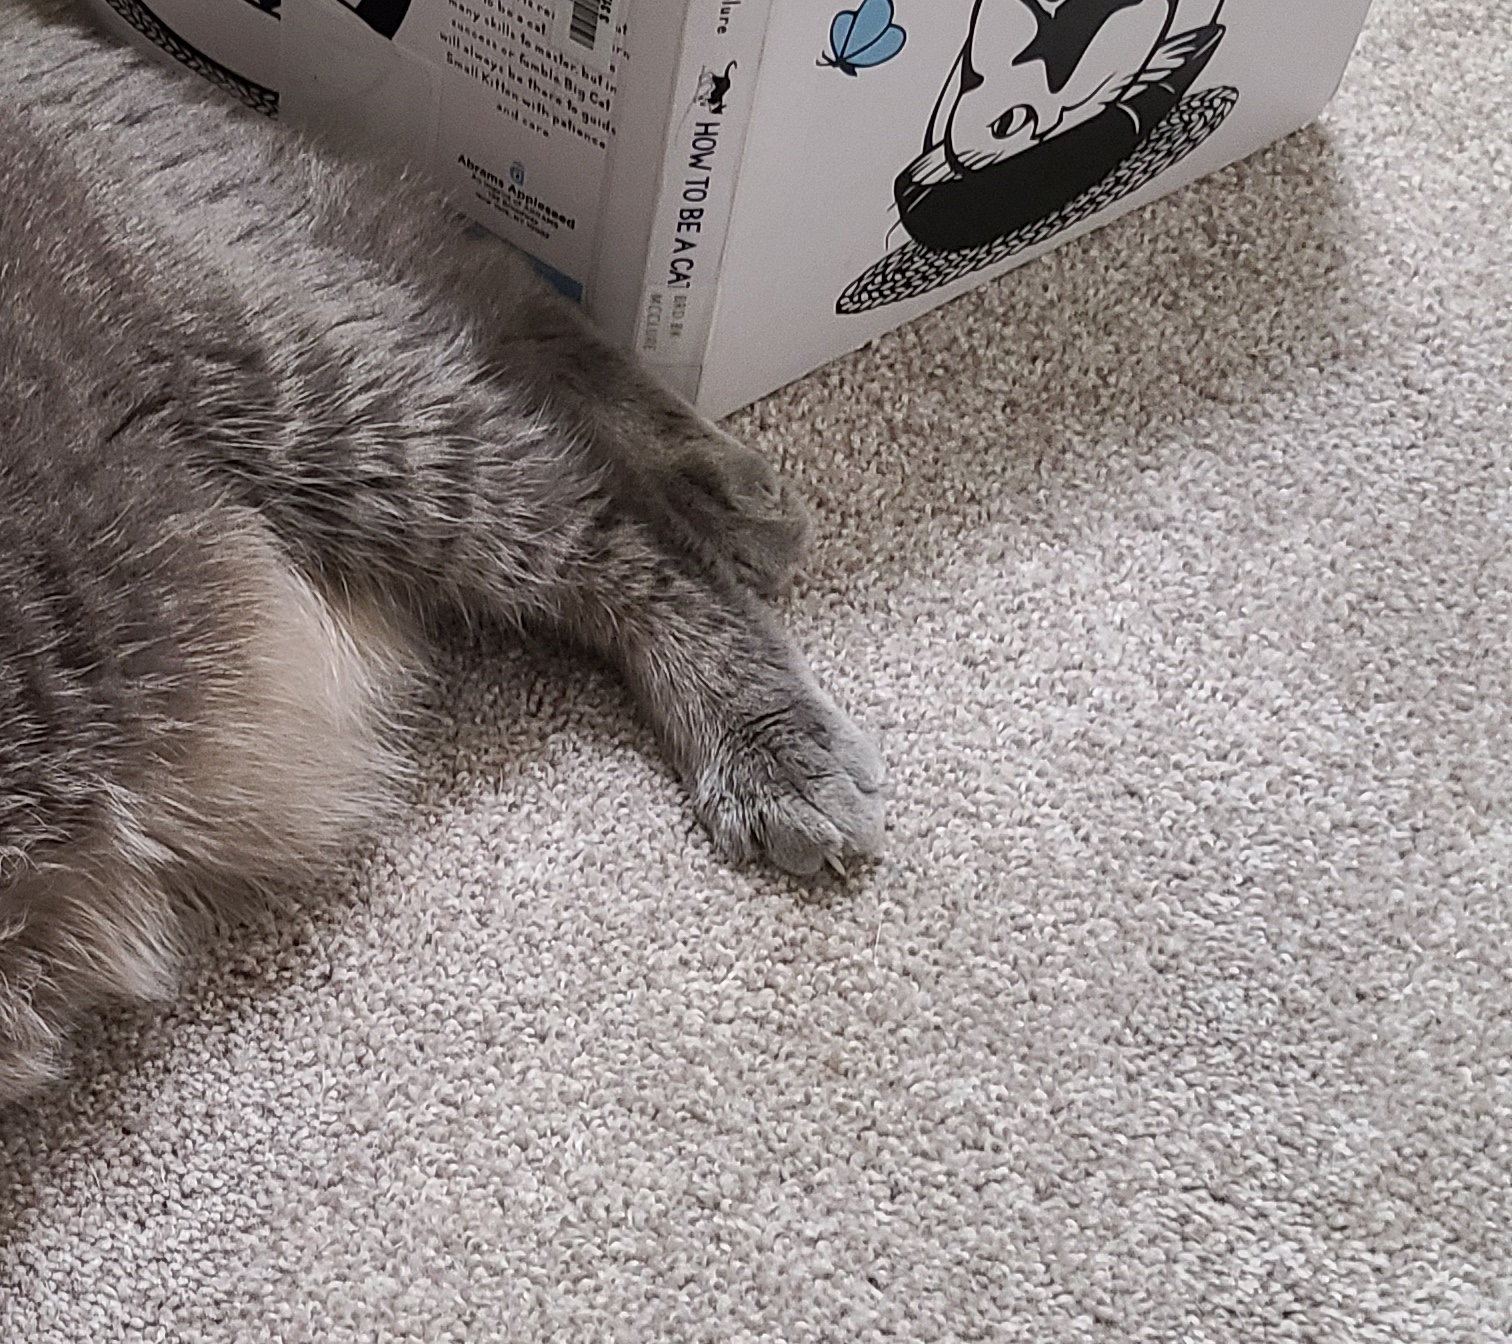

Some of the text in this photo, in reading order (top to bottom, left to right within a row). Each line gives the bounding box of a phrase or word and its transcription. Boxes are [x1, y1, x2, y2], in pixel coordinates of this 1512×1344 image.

[497, 0, 514, 18] be
[451, 19, 498, 51] success
[501, 46, 515, 58] or
[564, 77, 586, 103] Big
[589, 90, 611, 112] Cat
[484, 14, 516, 40] skills
[520, 31, 532, 49] to
[581, 64, 603, 85] but
[605, 80, 618, 95] in
[439, 31, 617, 136] will always be there to guide
[446, 50, 607, 150] Small Kitten with patience
[496, 103, 519, 122] and
[687, 121, 721, 172] HOW
[458, 154, 504, 189] Abrams
[508, 184, 576, 230] Appleseed
[682, 175, 711, 203] TO
[672, 237, 697, 254] A
[676, 207, 705, 234] BE
